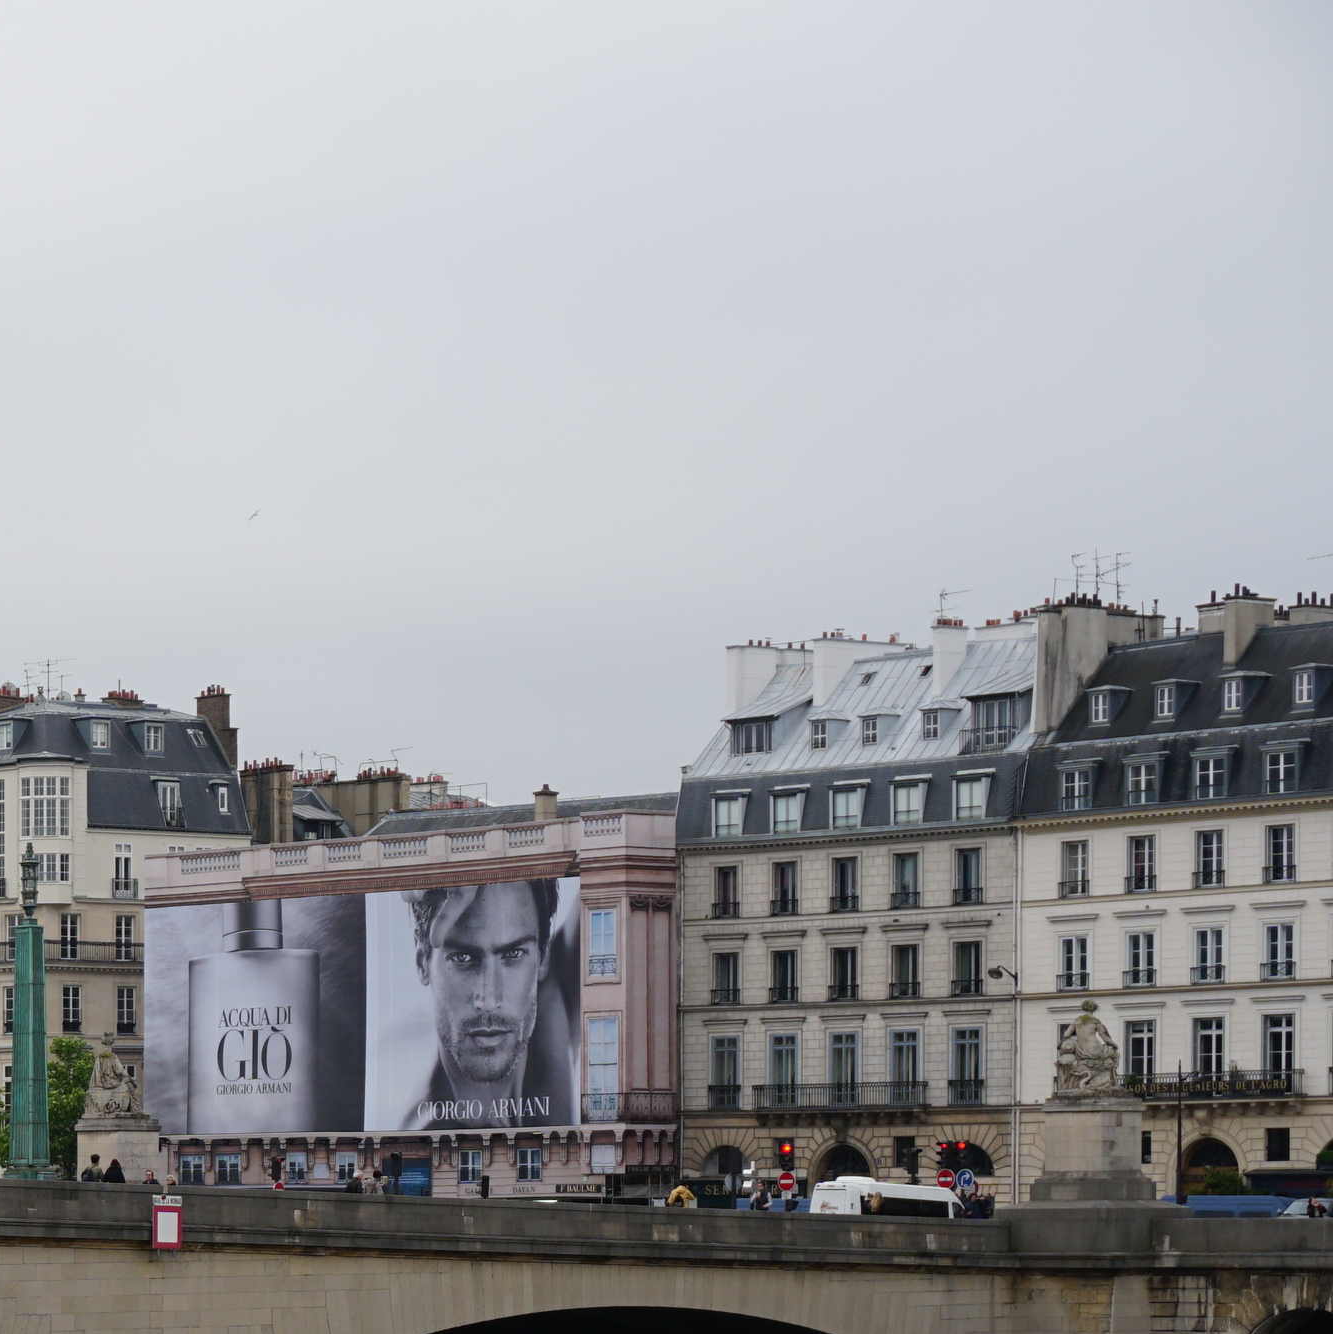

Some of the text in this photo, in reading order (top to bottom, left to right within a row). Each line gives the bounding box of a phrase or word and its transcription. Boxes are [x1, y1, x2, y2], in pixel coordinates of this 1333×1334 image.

[217, 1006, 293, 1028] ACQUA DI
[216, 1025, 293, 1082] GIÒ
[216, 1082, 292, 1095] GIORGIO ARMANI
[1150, 1082, 1167, 1093] DES
[1236, 1080, 1247, 1090] DE
[417, 1096, 550, 1120] GIORGIO ARMANI
[512, 1186, 536, 1194] DAYAN
[560, 1184, 598, 1193] F BAULME
